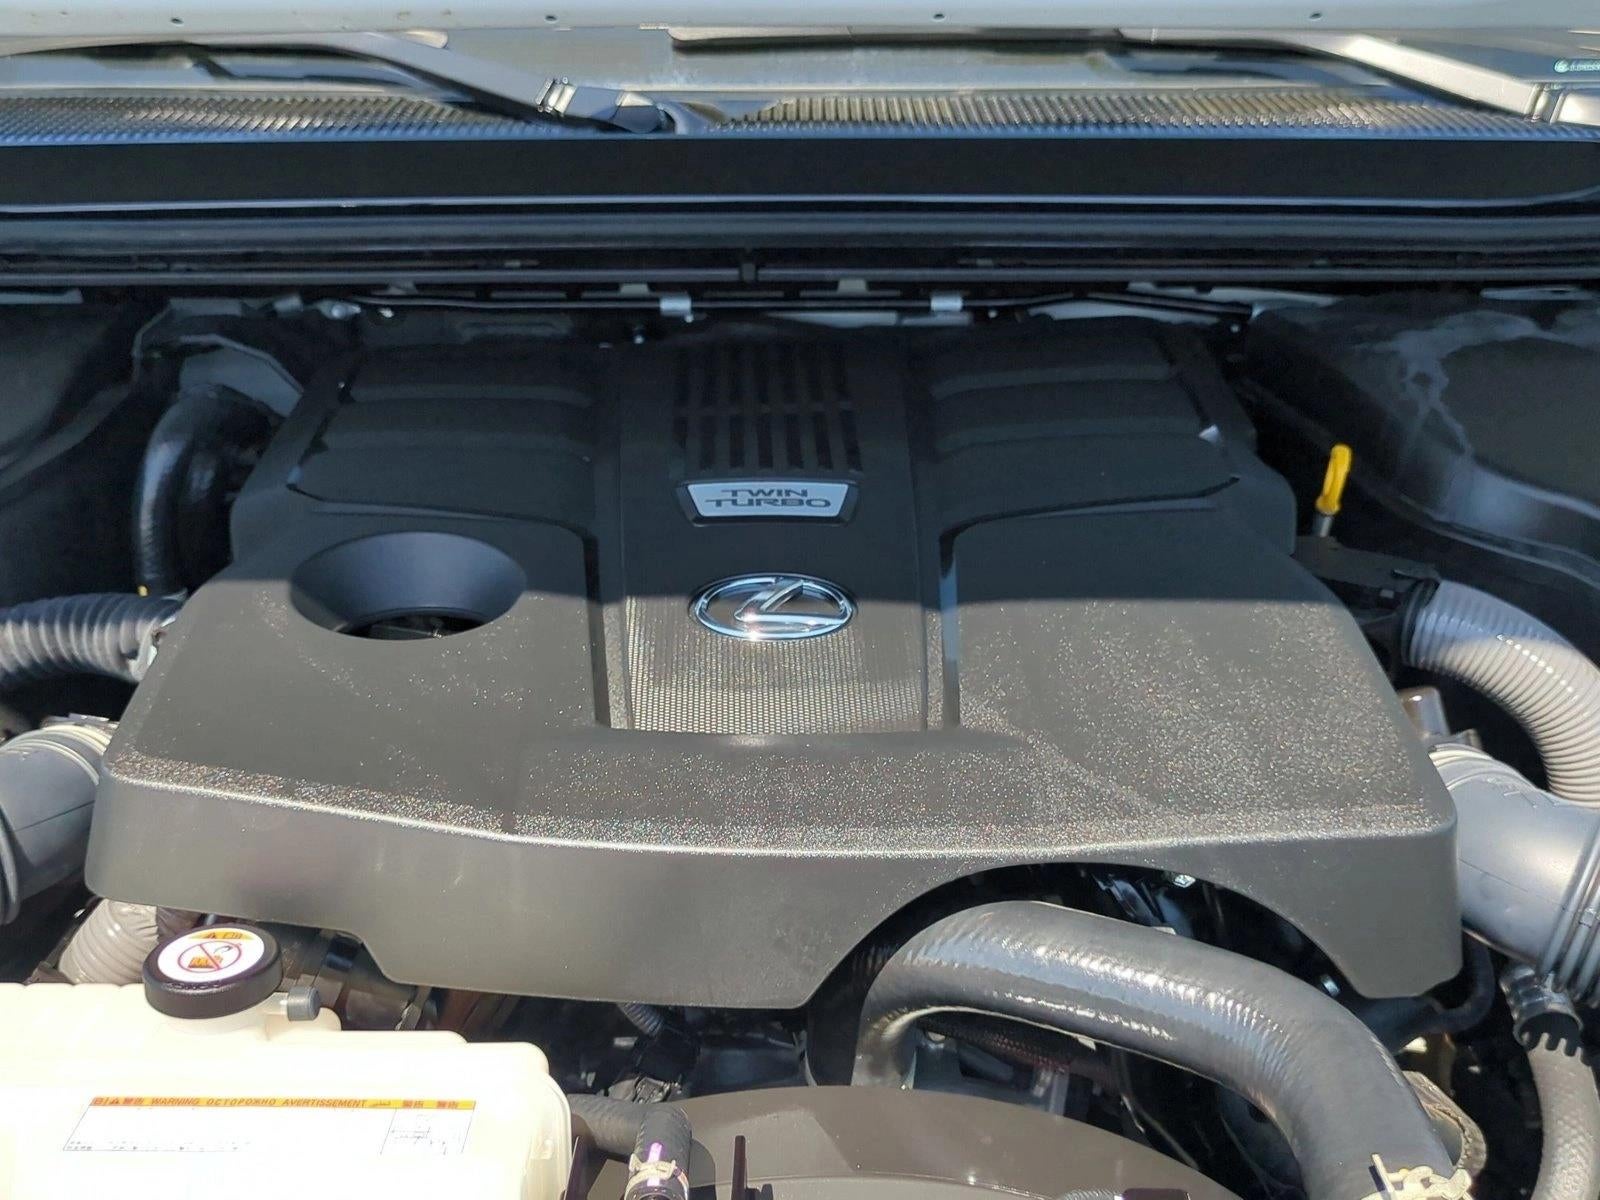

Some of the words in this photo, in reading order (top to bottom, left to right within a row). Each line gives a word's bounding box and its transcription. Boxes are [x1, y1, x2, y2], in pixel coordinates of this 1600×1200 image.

[721, 489, 808, 497] TWIN
[706, 498, 831, 507] TURBO
[151, 1097, 201, 1105] WARNING
[206, 1098, 277, 1106] ОСТОРОЖНО
[282, 1098, 368, 1108] AVERTISSEMENT
